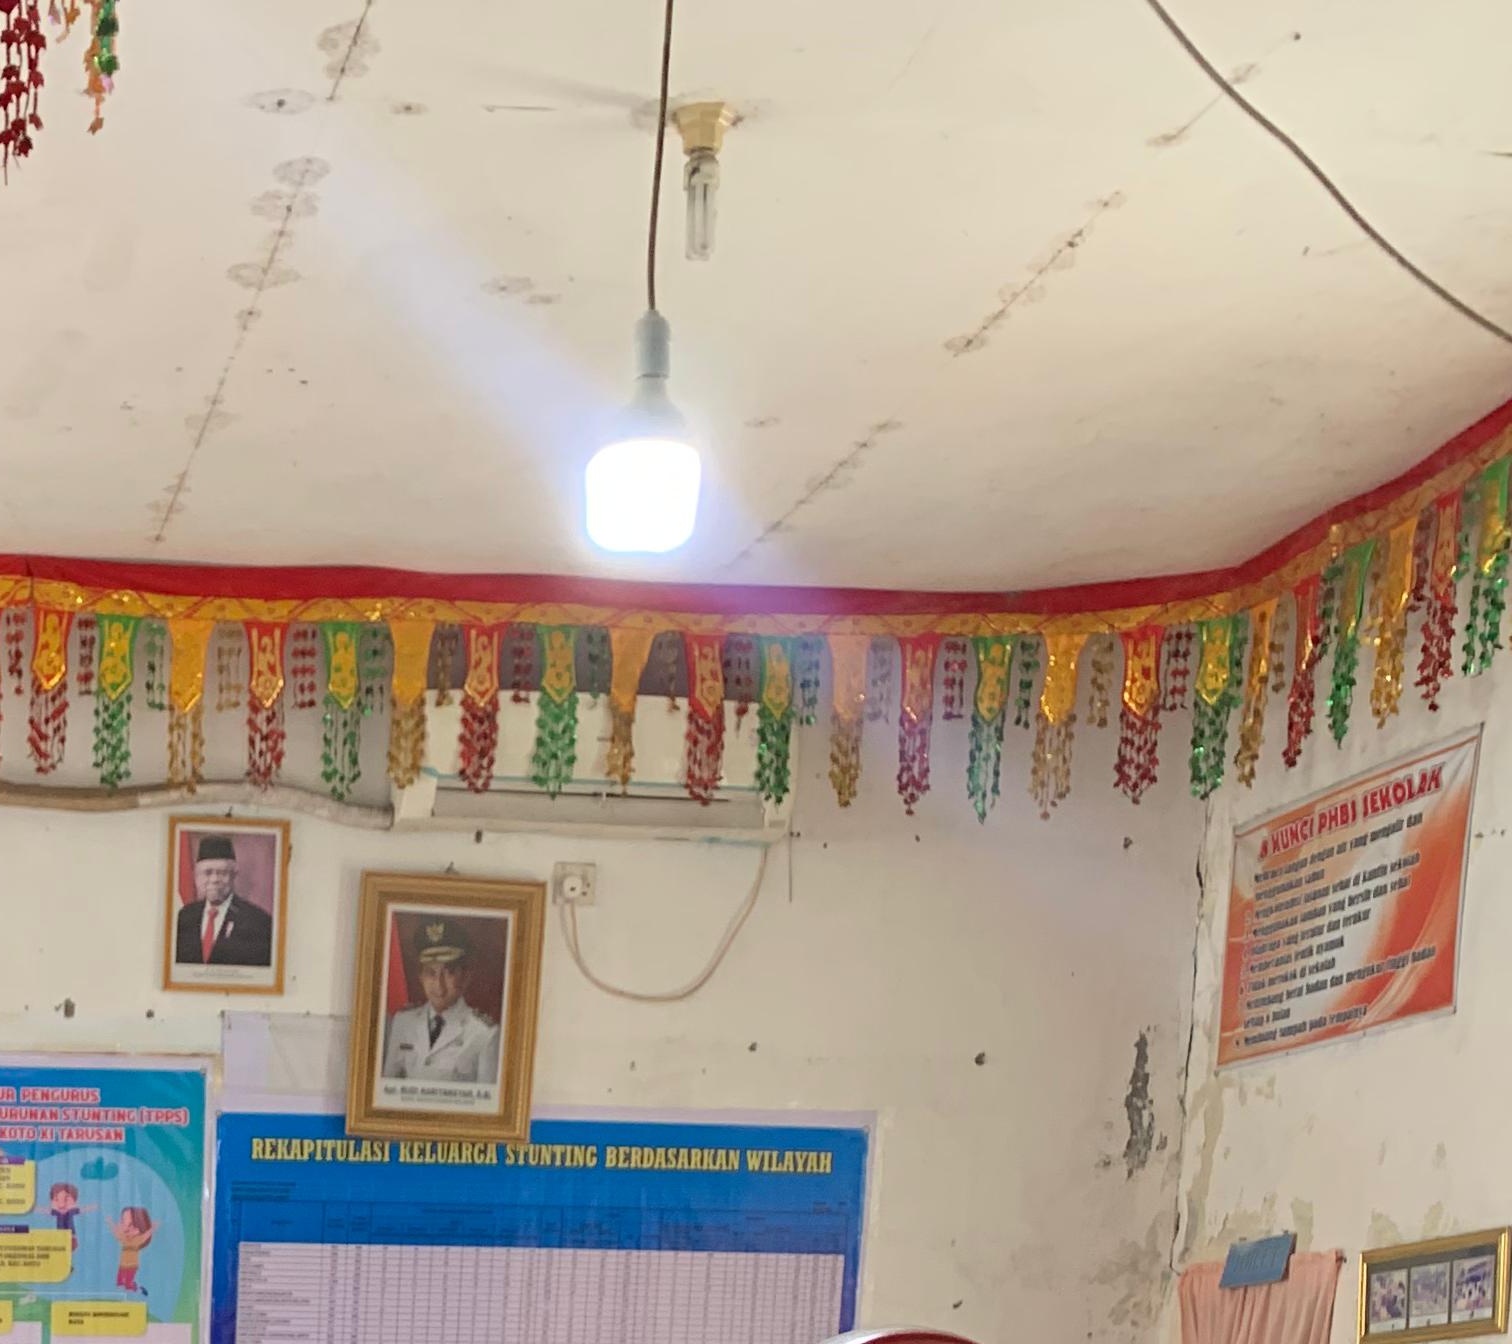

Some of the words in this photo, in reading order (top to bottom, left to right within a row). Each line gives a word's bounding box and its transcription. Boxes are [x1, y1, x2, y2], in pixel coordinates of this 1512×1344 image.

[1271, 818, 1314, 855] KUNCI
[1362, 765, 1443, 818] SEKOLAH
[21, 1088, 99, 1102] PENGURUS
[62, 1108, 136, 1123] STUNTING
[139, 1108, 189, 1124] (TPPS)
[0, 1126, 36, 1141] KOTO
[40, 1127, 56, 1141] XI
[59, 1127, 125, 1142] TARUSAN
[251, 1138, 390, 1162] REKAPITULASI
[398, 1141, 498, 1165] KELUARGA
[505, 1144, 598, 1167] STUNTING
[605, 1147, 740, 1171] BERDASARKAN
[746, 1150, 833, 1174] WILAYAH
